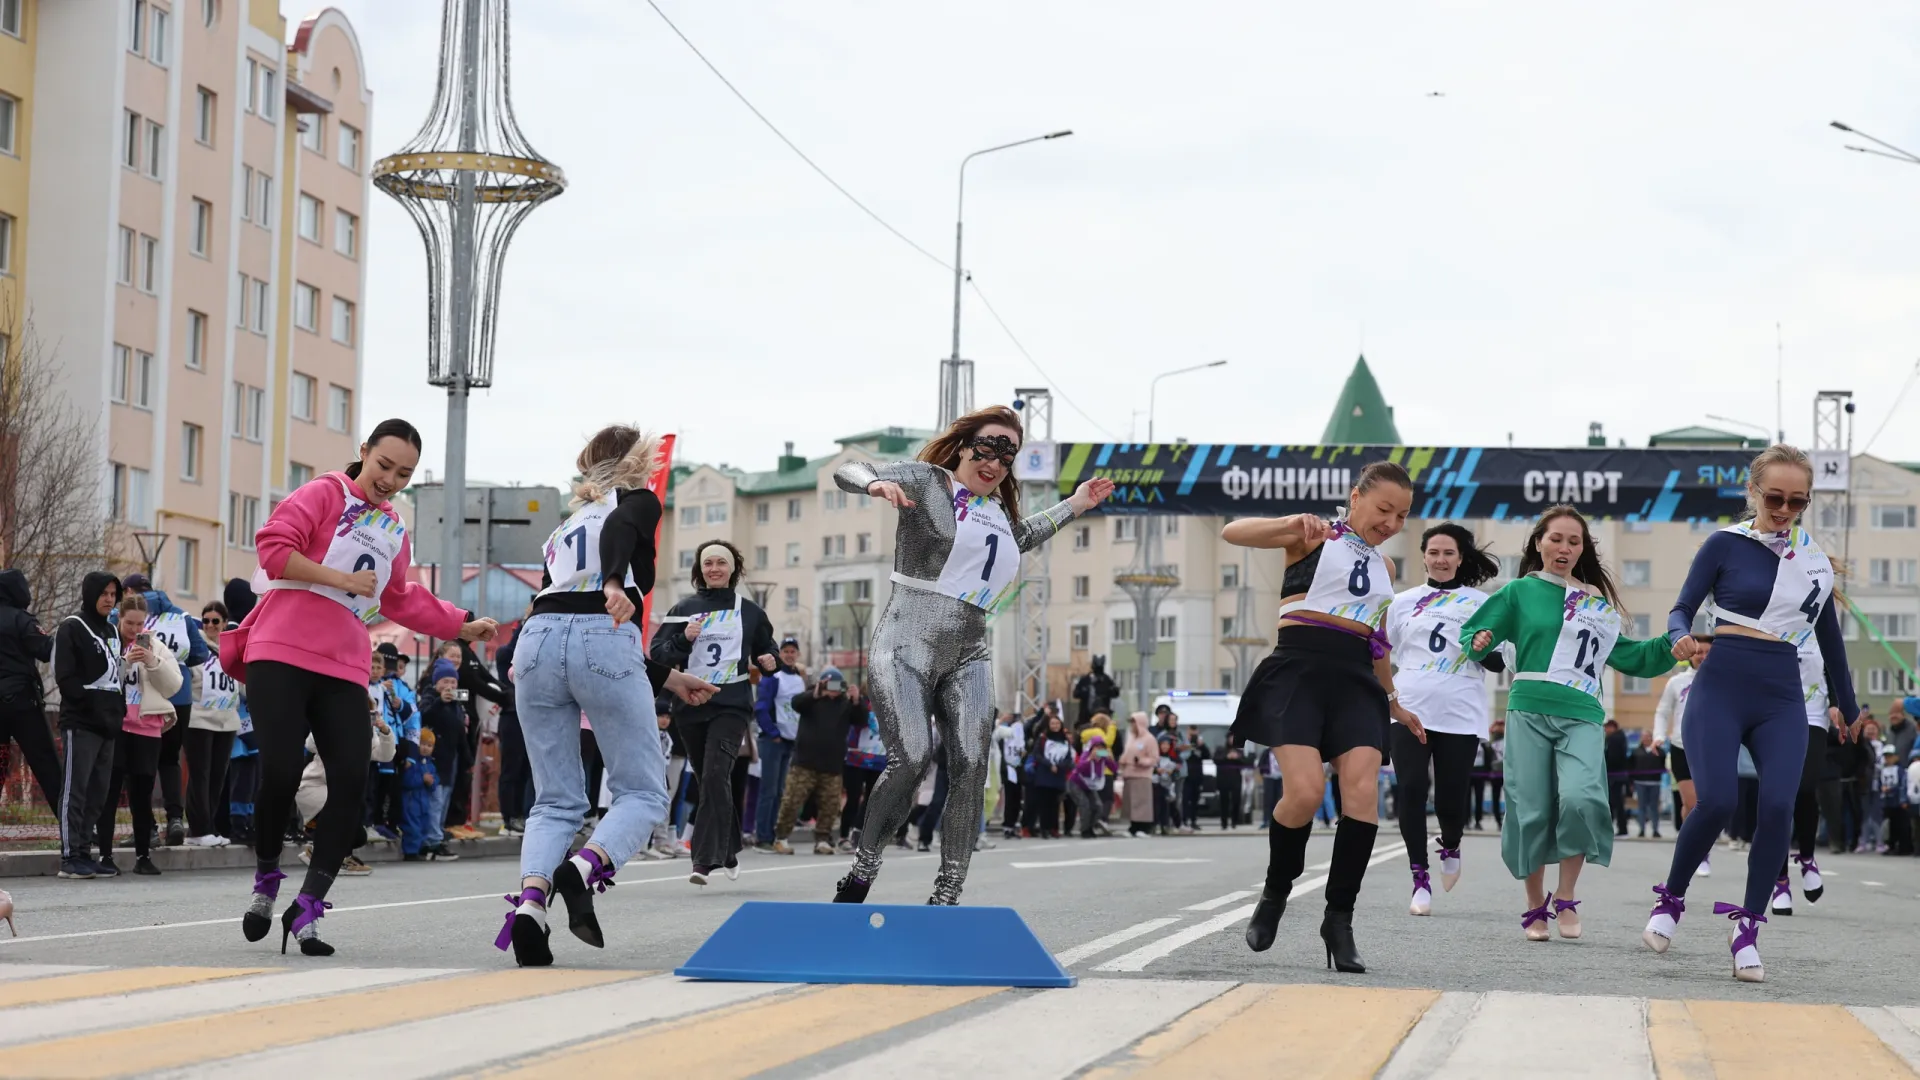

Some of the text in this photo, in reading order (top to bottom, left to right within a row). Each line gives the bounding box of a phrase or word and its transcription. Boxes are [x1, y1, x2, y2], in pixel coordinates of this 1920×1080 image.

[1221, 465, 1350, 501] ФИНИШ
[1523, 470, 1623, 504] СТАРТ
[1697, 465, 1751, 485] ЯМА
[1104, 486, 1165, 504] МАЛ
[352, 535, 361, 544] НА
[563, 525, 587, 572] 7
[981, 533, 999, 582] 1
[1347, 555, 1371, 597] 8
[1799, 578, 1822, 625] 4
[1428, 621, 1447, 654] 6
[1573, 628, 1600, 680] 12
[706, 642, 722, 668] 3
[209, 670, 235, 693] 108
